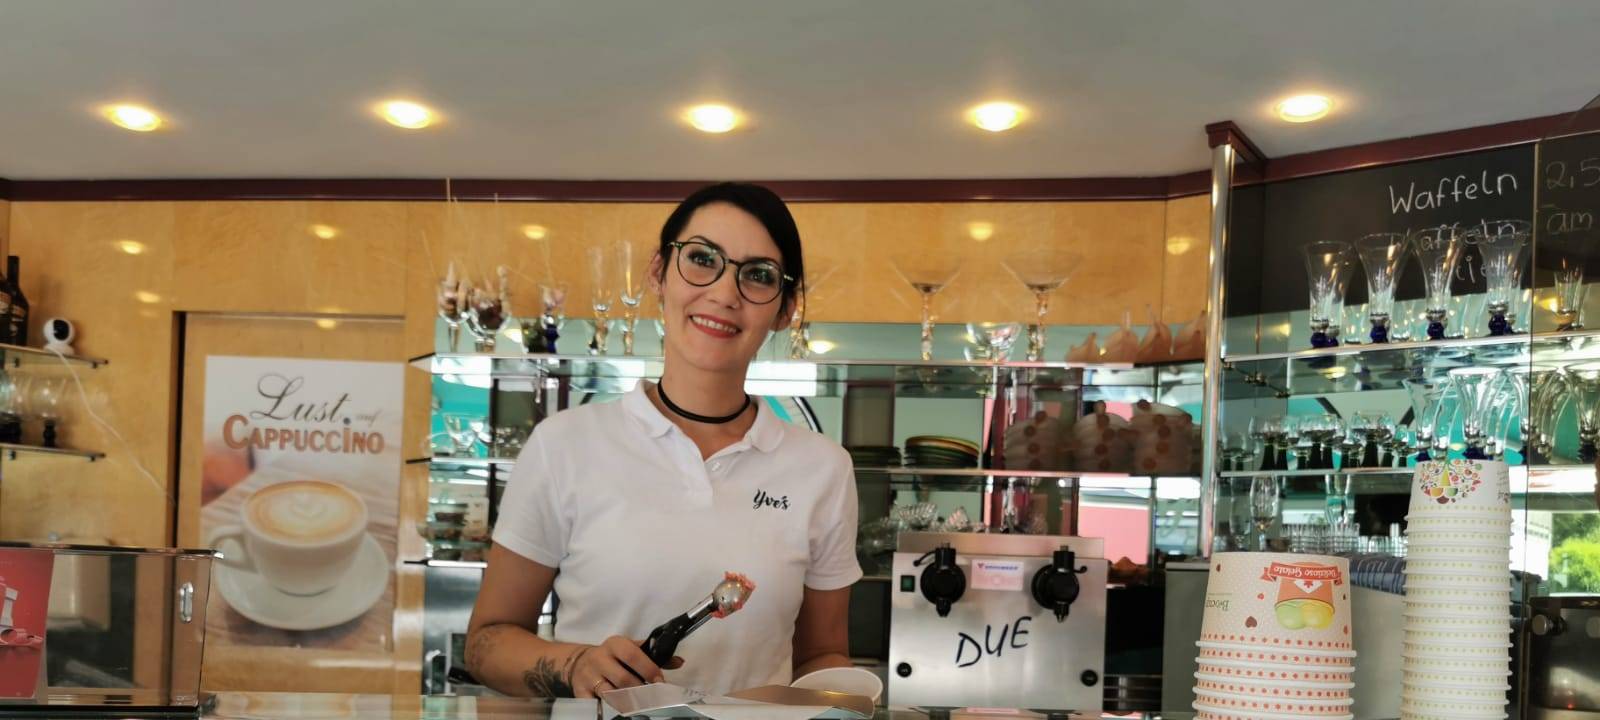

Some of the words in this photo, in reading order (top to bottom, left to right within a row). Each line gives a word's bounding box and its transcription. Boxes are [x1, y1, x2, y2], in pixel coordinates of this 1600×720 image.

[1389, 170, 1518, 214] Waffeln
[1405, 219, 1516, 250] affeln
[250, 372, 352, 424] Lust
[753, 488, 789, 510] Yve's
[1273, 566, 1303, 578] Gelato
[955, 615, 1032, 668] DUE
